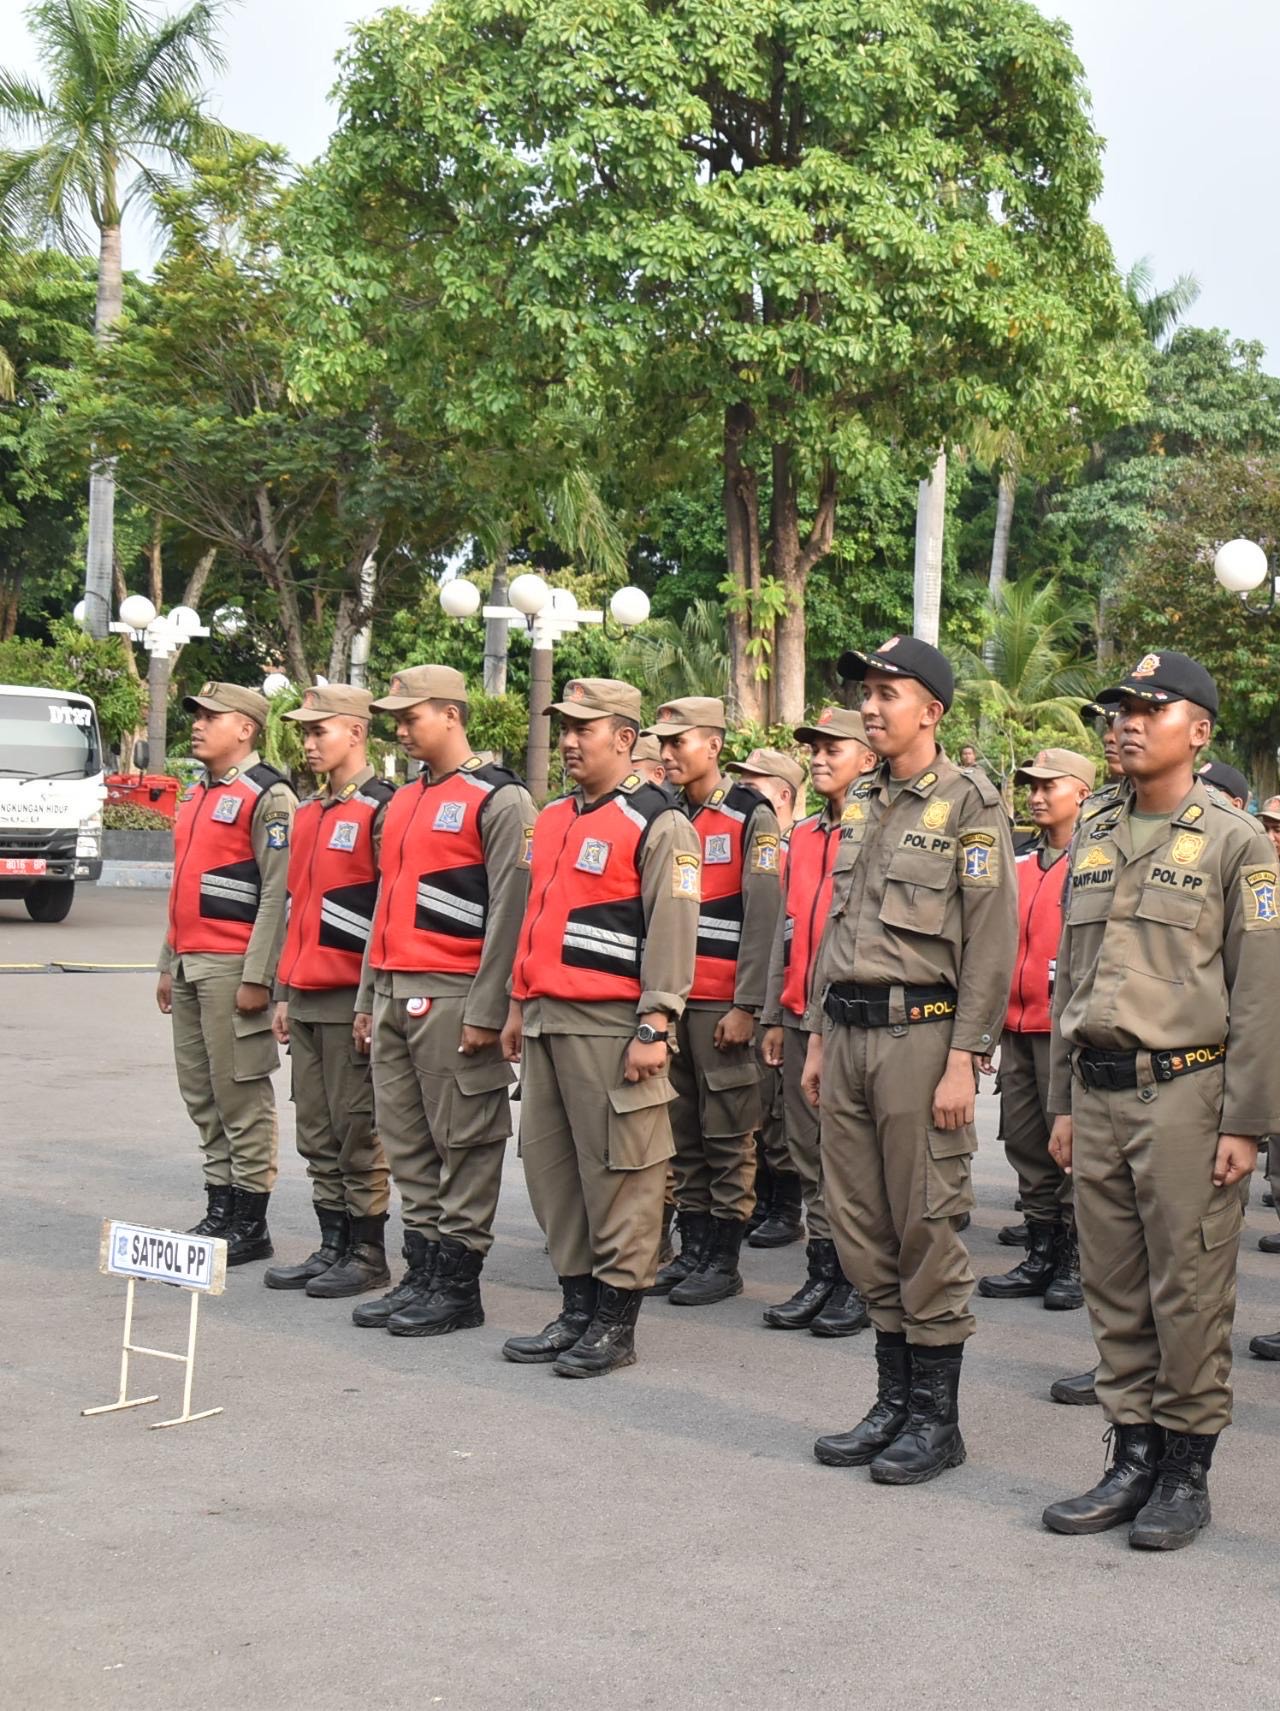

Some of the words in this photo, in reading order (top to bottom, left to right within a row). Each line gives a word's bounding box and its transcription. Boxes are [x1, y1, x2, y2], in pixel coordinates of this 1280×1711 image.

[903, 833, 927, 850] POL
[931, 838, 950, 854] PP
[1151, 868, 1177, 886] POL
[1182, 874, 1203, 890] PP
[131, 1235, 181, 1273] SATPOL
[187, 1245, 206, 1276] PP
